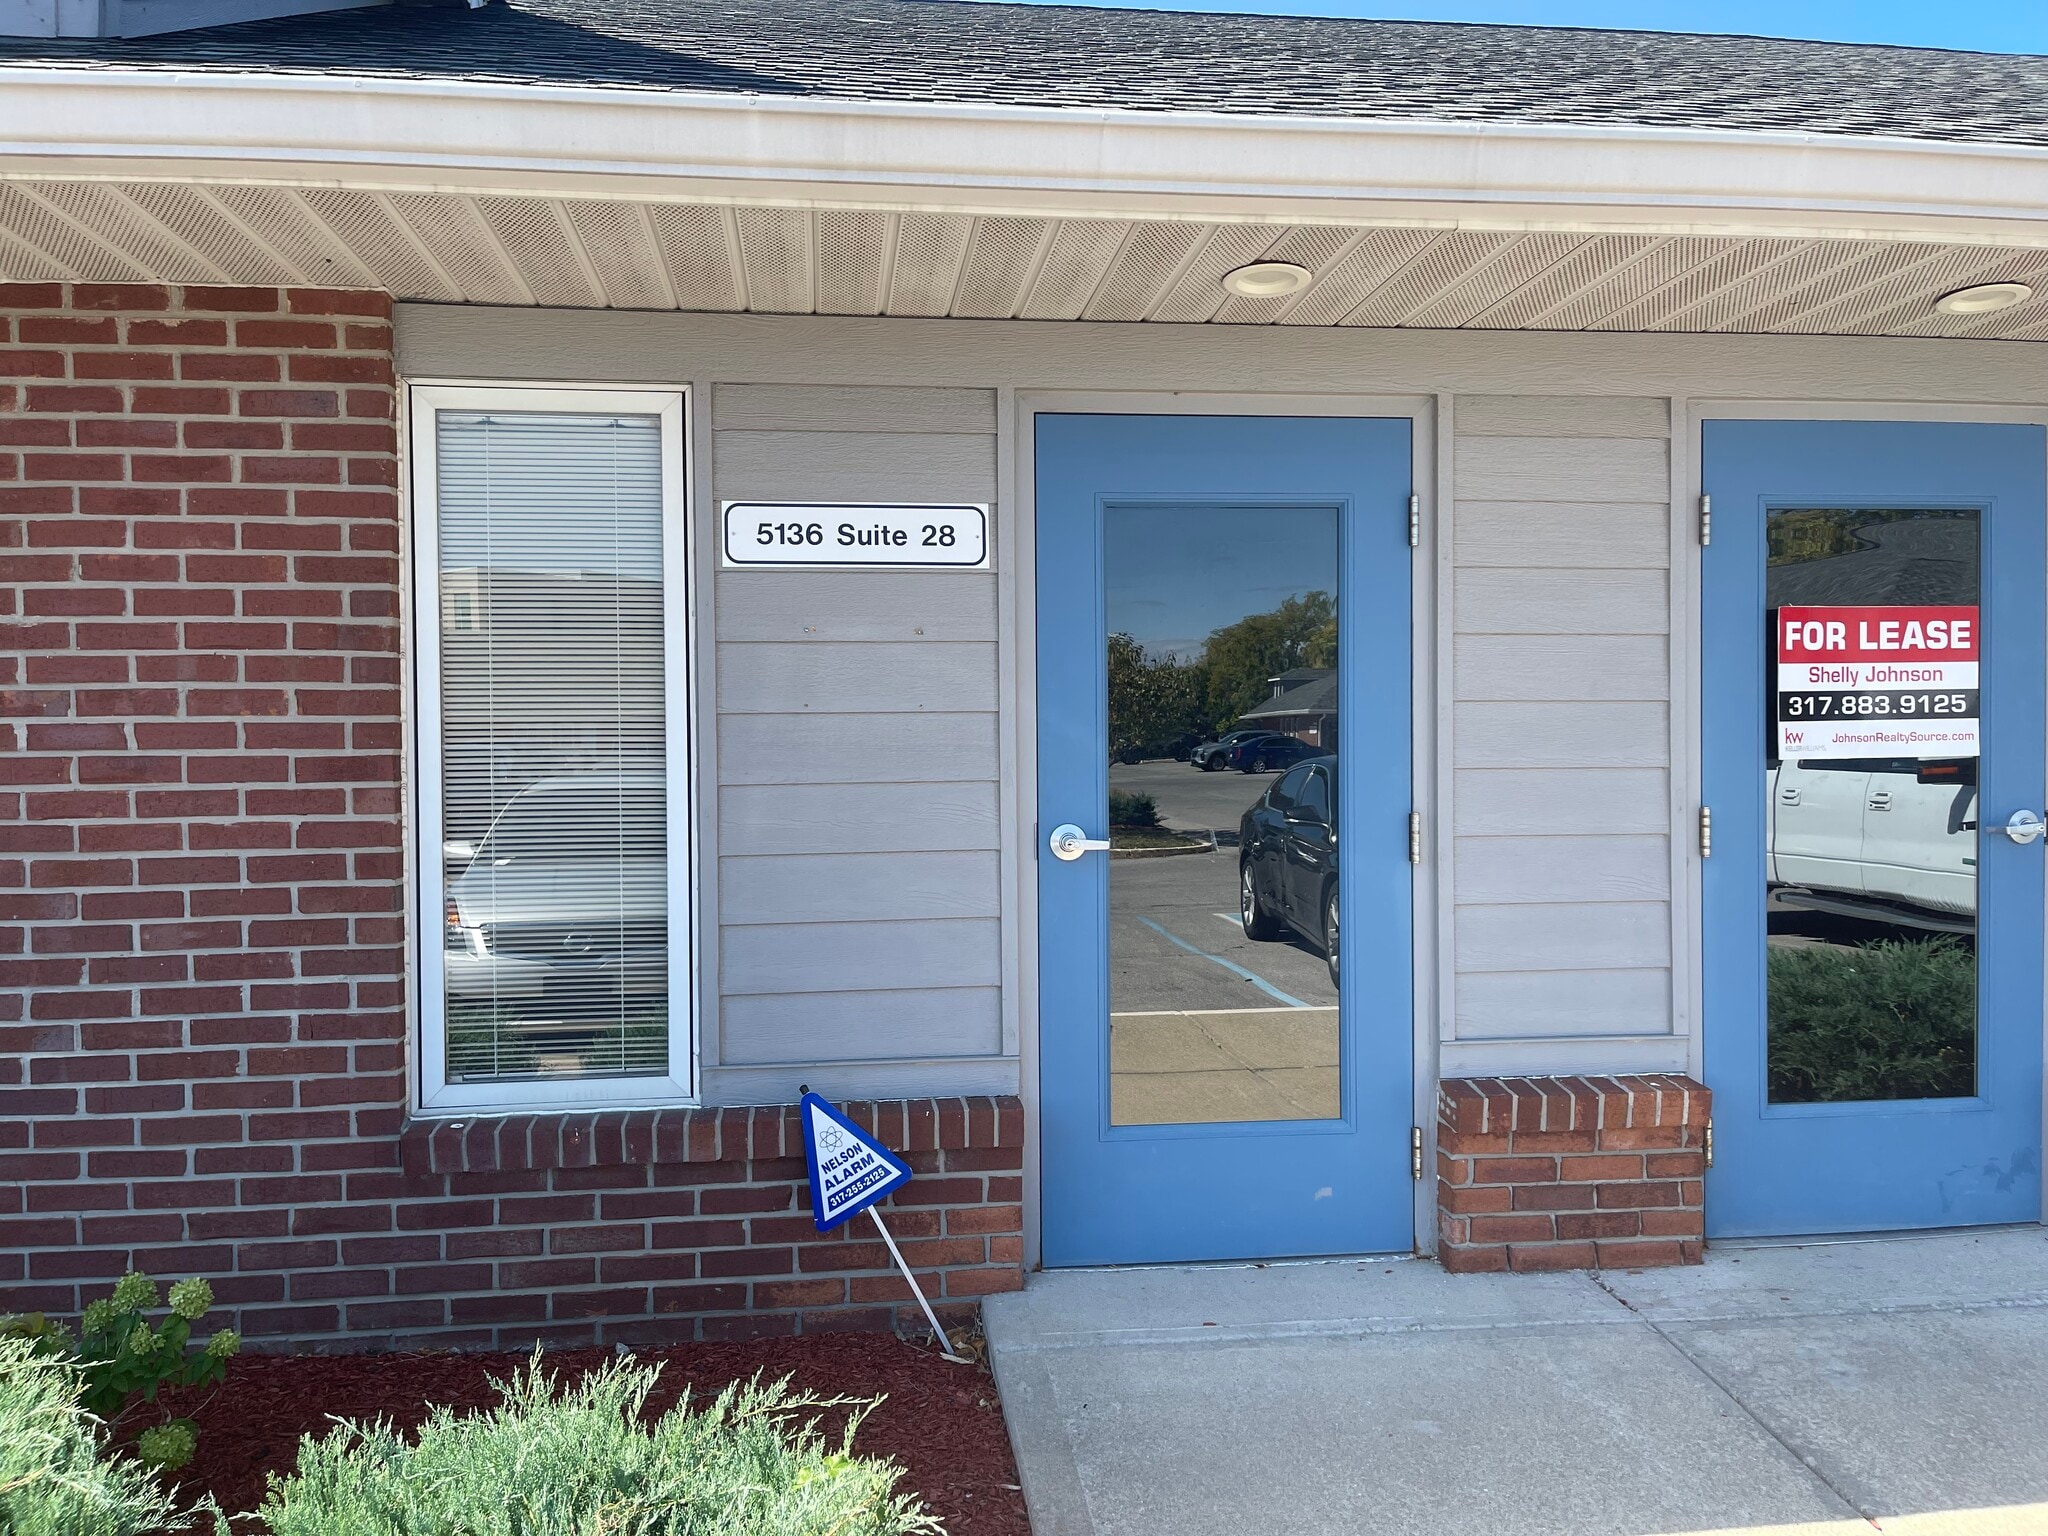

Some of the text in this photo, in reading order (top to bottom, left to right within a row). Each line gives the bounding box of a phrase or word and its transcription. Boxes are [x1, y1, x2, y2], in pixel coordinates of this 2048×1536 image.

[756, 523, 956, 547] 5136 Suite 28
[1785, 620, 1971, 650] FOR LEASE
[1809, 666, 1943, 687] Shelly Johnson
[1788, 694, 1967, 716] 317.883.9125
[1785, 728, 1804, 744] kw
[1832, 731, 1975, 743] JohnsonRealtySource.com
[821, 1142, 863, 1175] NELSON
[825, 1153, 875, 1191] ALARM
[830, 1167, 885, 1206] 317-255-2125
